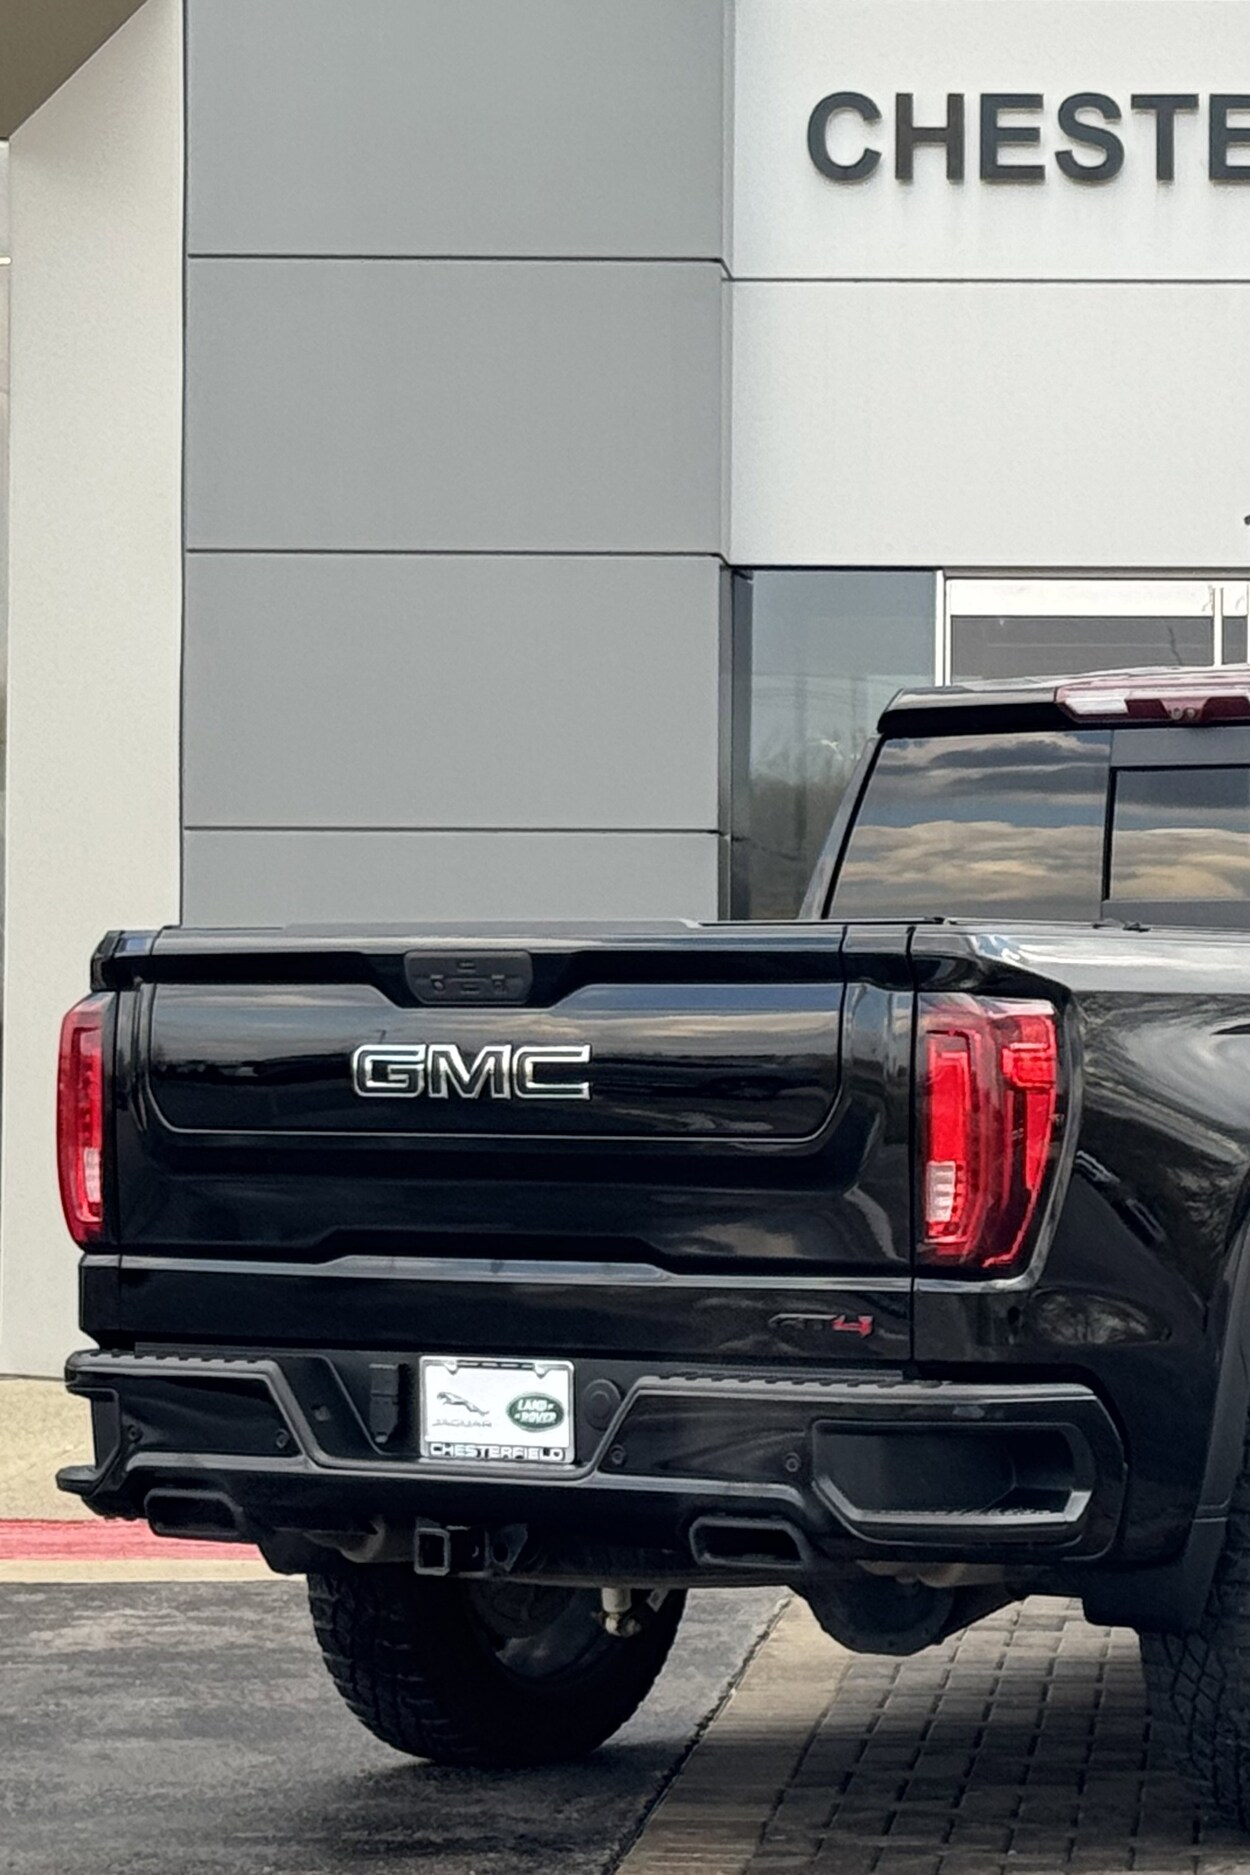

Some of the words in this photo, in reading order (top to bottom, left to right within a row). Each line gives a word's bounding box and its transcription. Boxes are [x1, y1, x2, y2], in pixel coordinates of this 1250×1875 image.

[353, 1043, 592, 1101] GMC
[517, 1398, 549, 1412] LAND
[519, 1410, 557, 1424] ROVER
[429, 1443, 565, 1461] CHESTERFIELD
